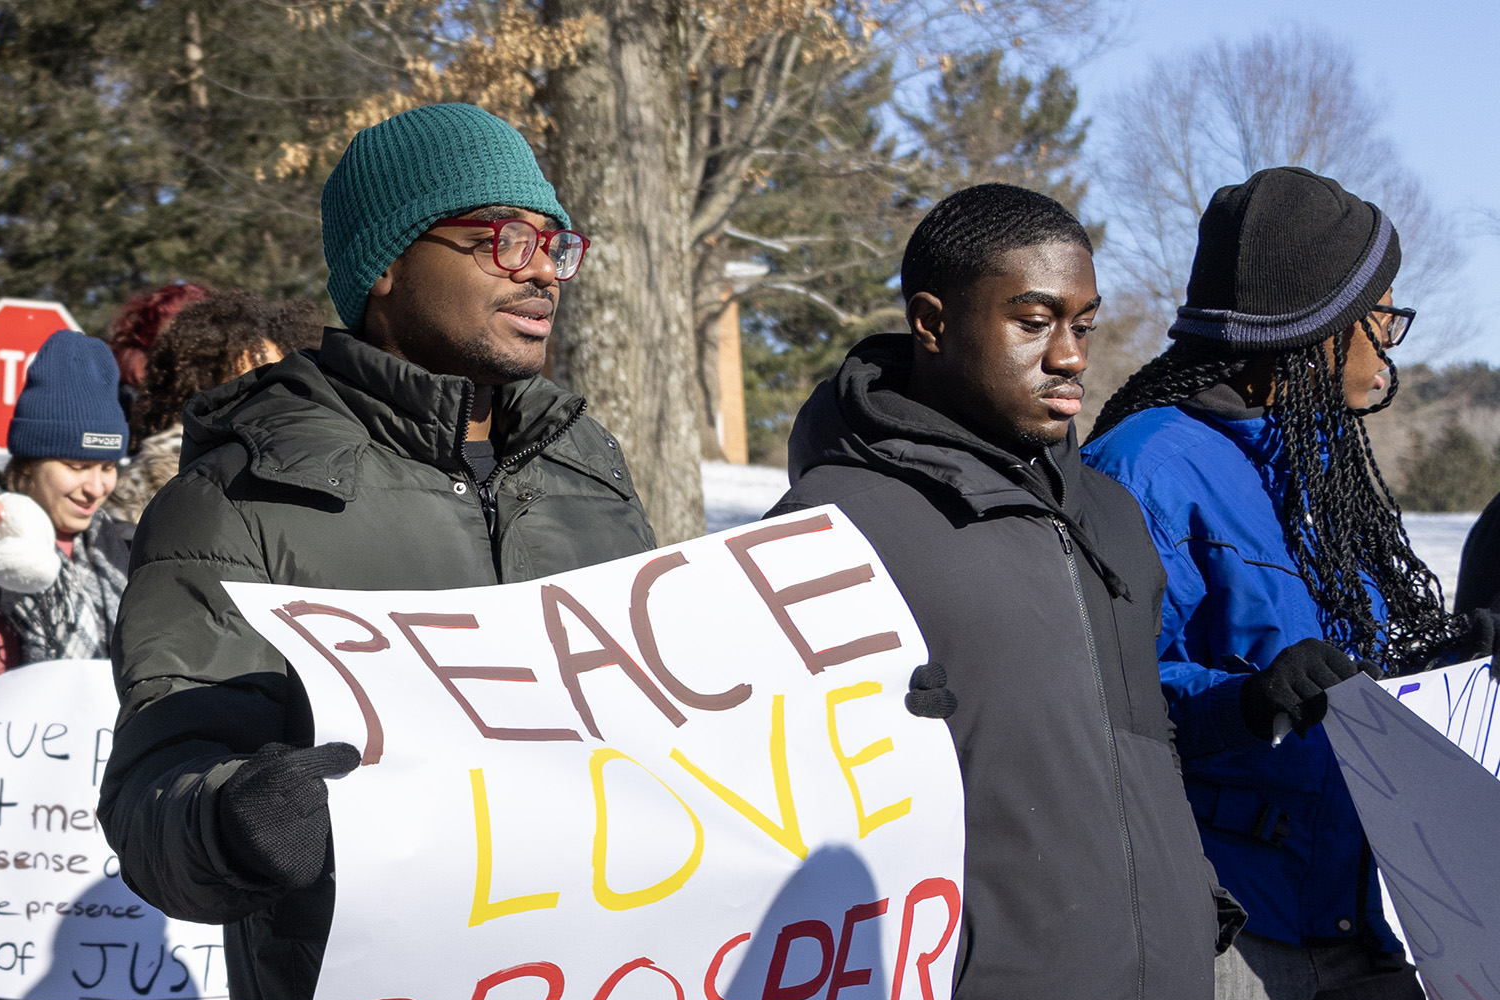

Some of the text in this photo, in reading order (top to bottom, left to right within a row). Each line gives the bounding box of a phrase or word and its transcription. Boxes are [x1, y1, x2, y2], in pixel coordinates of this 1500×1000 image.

[84, 436, 121, 446] SPYDER
[270, 513, 903, 766] PEACE
[468, 681, 912, 927] LOVE
[25, 900, 146, 922] presence
[72, 941, 230, 996] JUST
